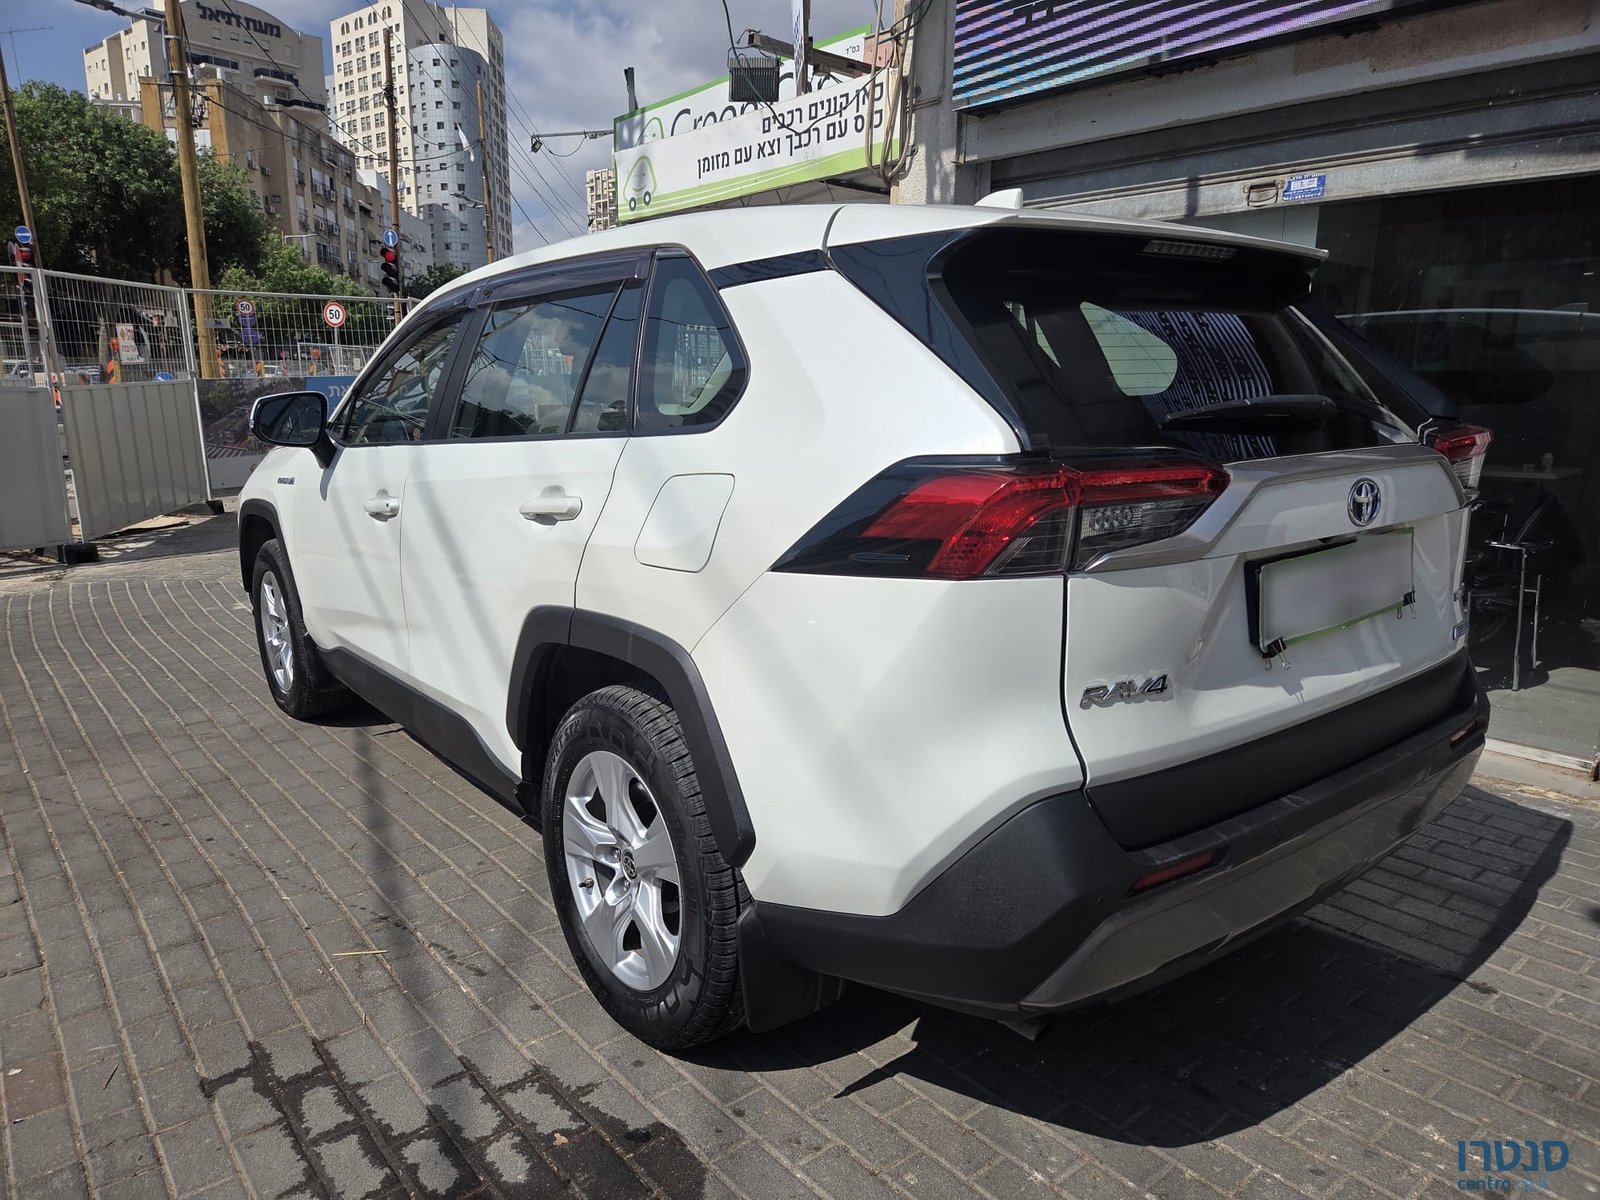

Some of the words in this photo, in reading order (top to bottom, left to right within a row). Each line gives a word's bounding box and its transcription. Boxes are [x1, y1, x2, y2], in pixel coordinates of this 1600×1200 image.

[808, 92, 850, 121] קונים
[762, 107, 803, 134] רכבים
[826, 119, 848, 141] עם
[854, 108, 883, 133] כס
[757, 138, 781, 159] וצא
[786, 127, 821, 156] רכבך
[697, 151, 730, 179] מזומן
[734, 145, 752, 165] עם
[240, 303, 251, 311] 50
[329, 309, 340, 320] 50
[1080, 673, 1168, 705] RAV4
